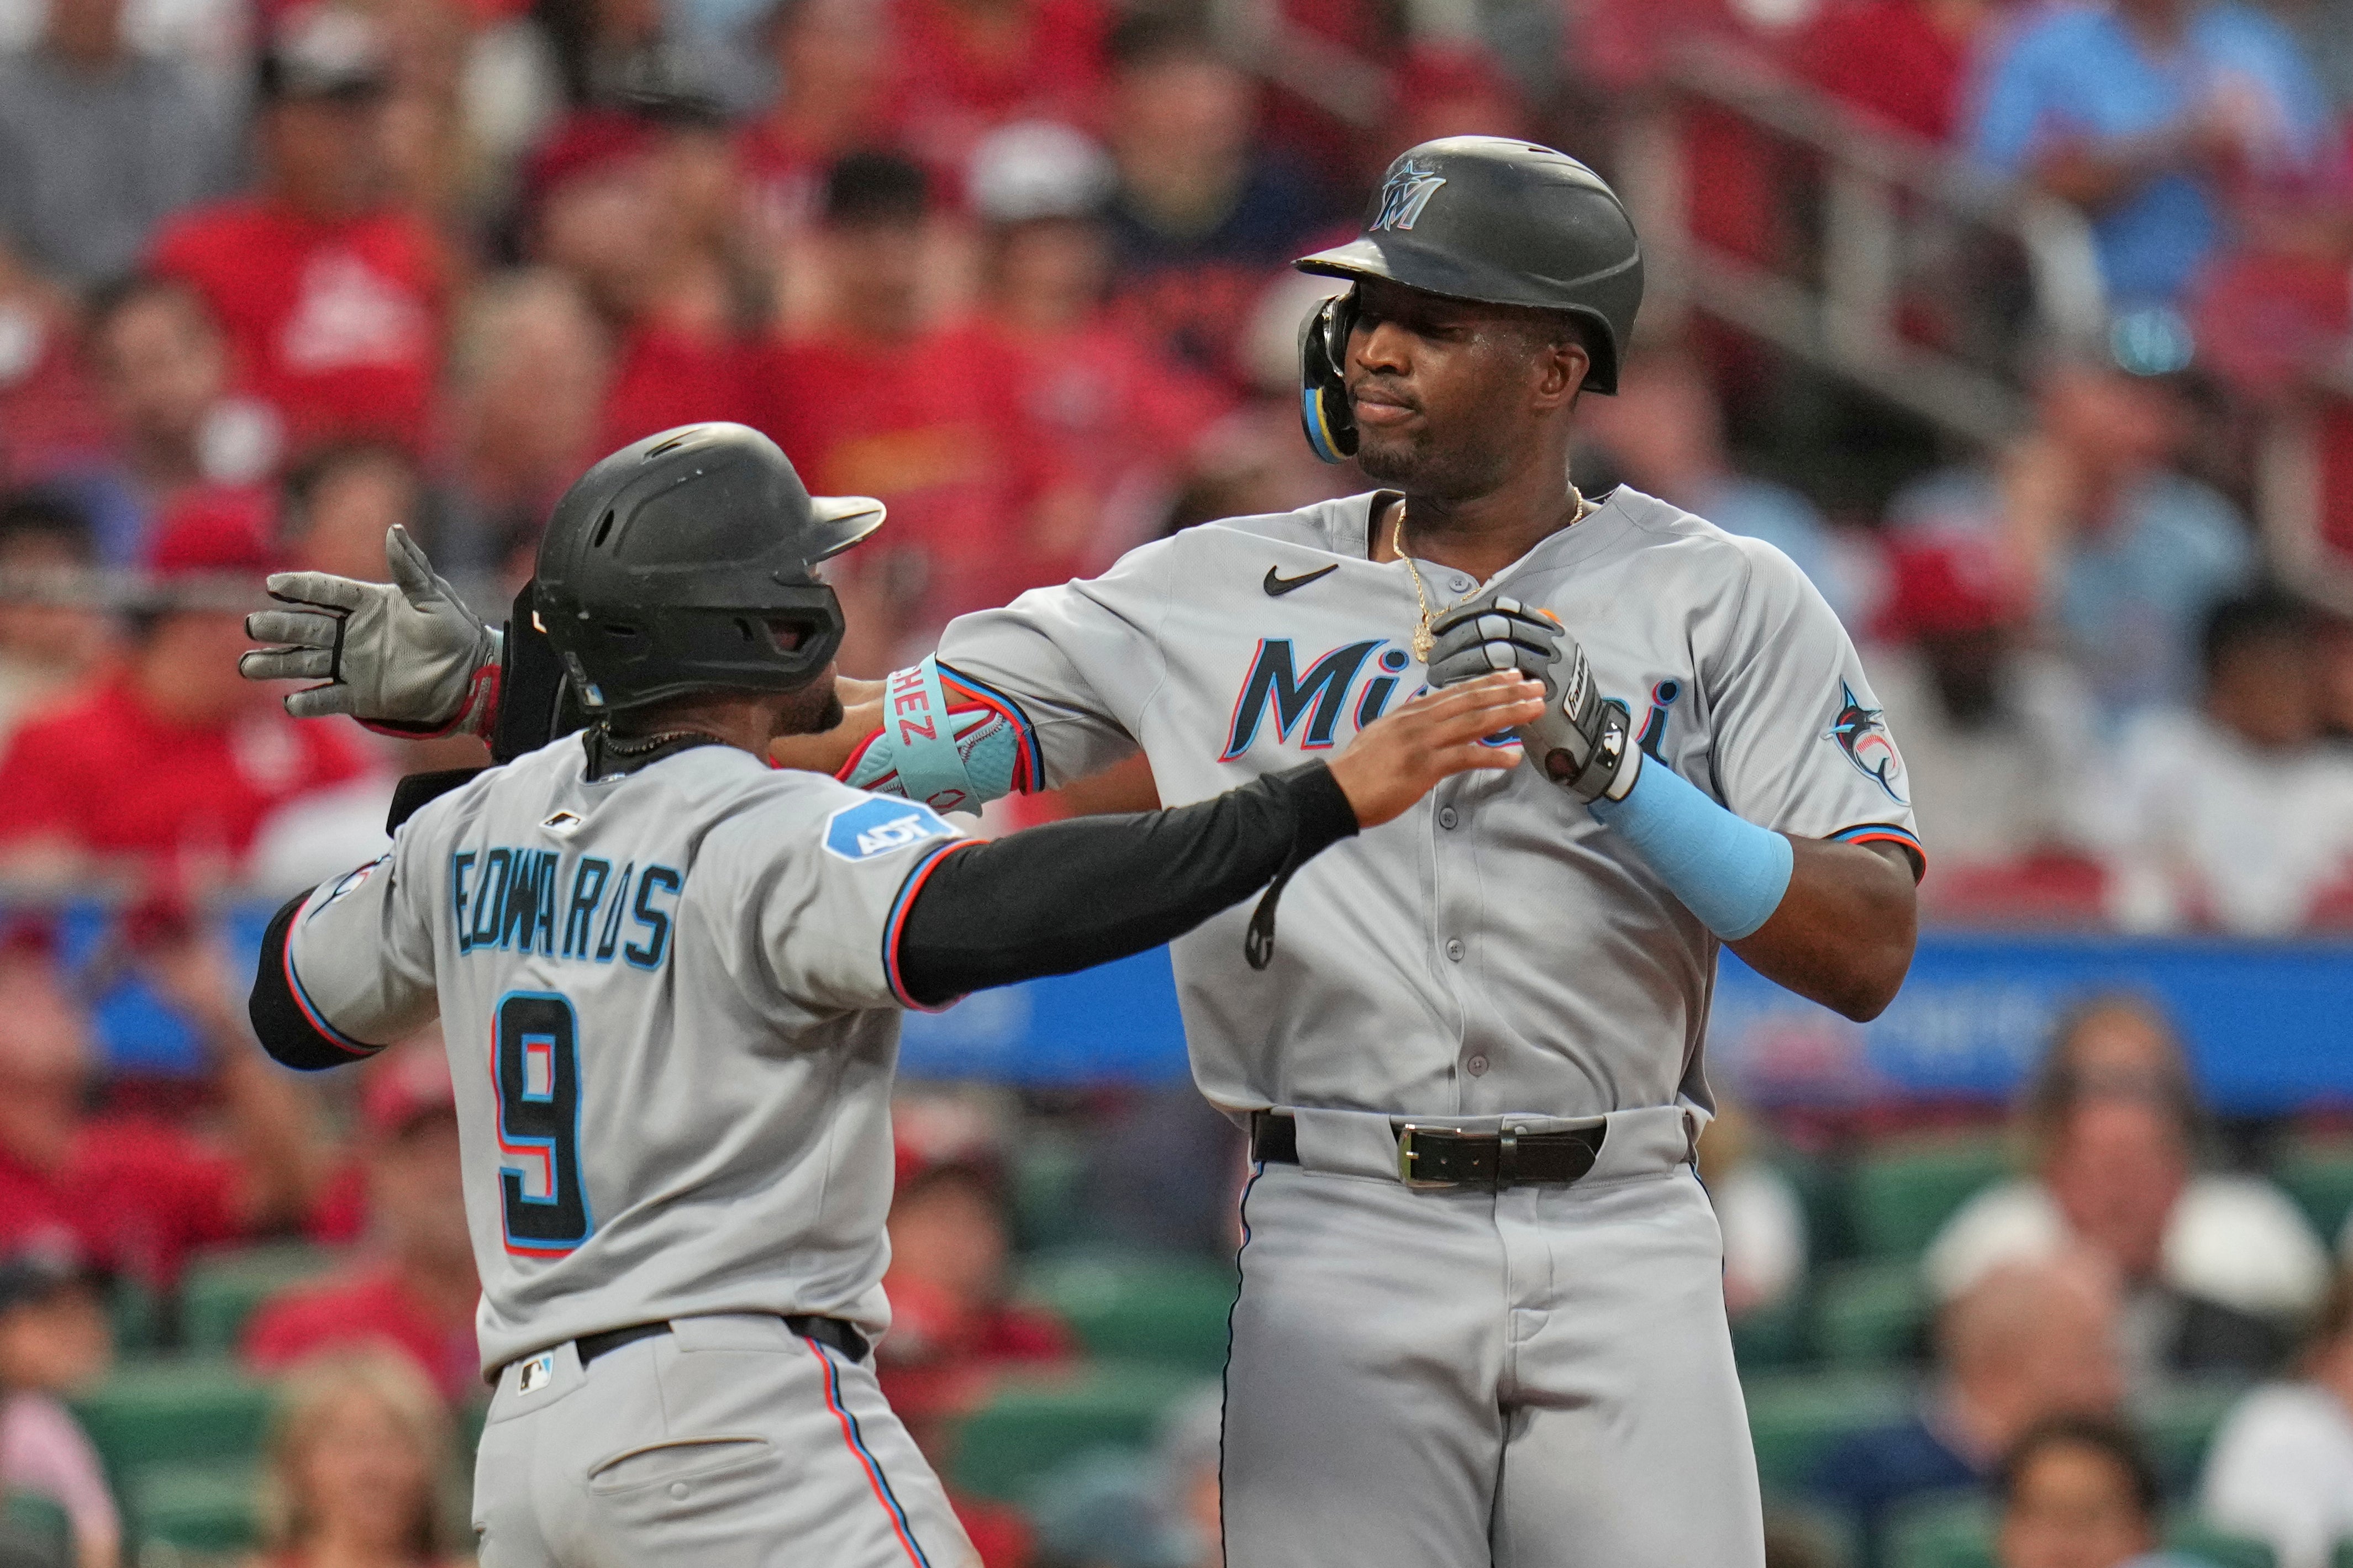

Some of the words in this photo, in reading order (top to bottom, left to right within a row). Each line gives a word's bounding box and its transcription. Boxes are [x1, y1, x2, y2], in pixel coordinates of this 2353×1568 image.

[891, 667, 938, 746] HEZ
[1217, 637, 1680, 767] Mii
[856, 813, 930, 854] ADT
[452, 846, 685, 971] EDWARDS
[489, 990, 594, 1258] 9
